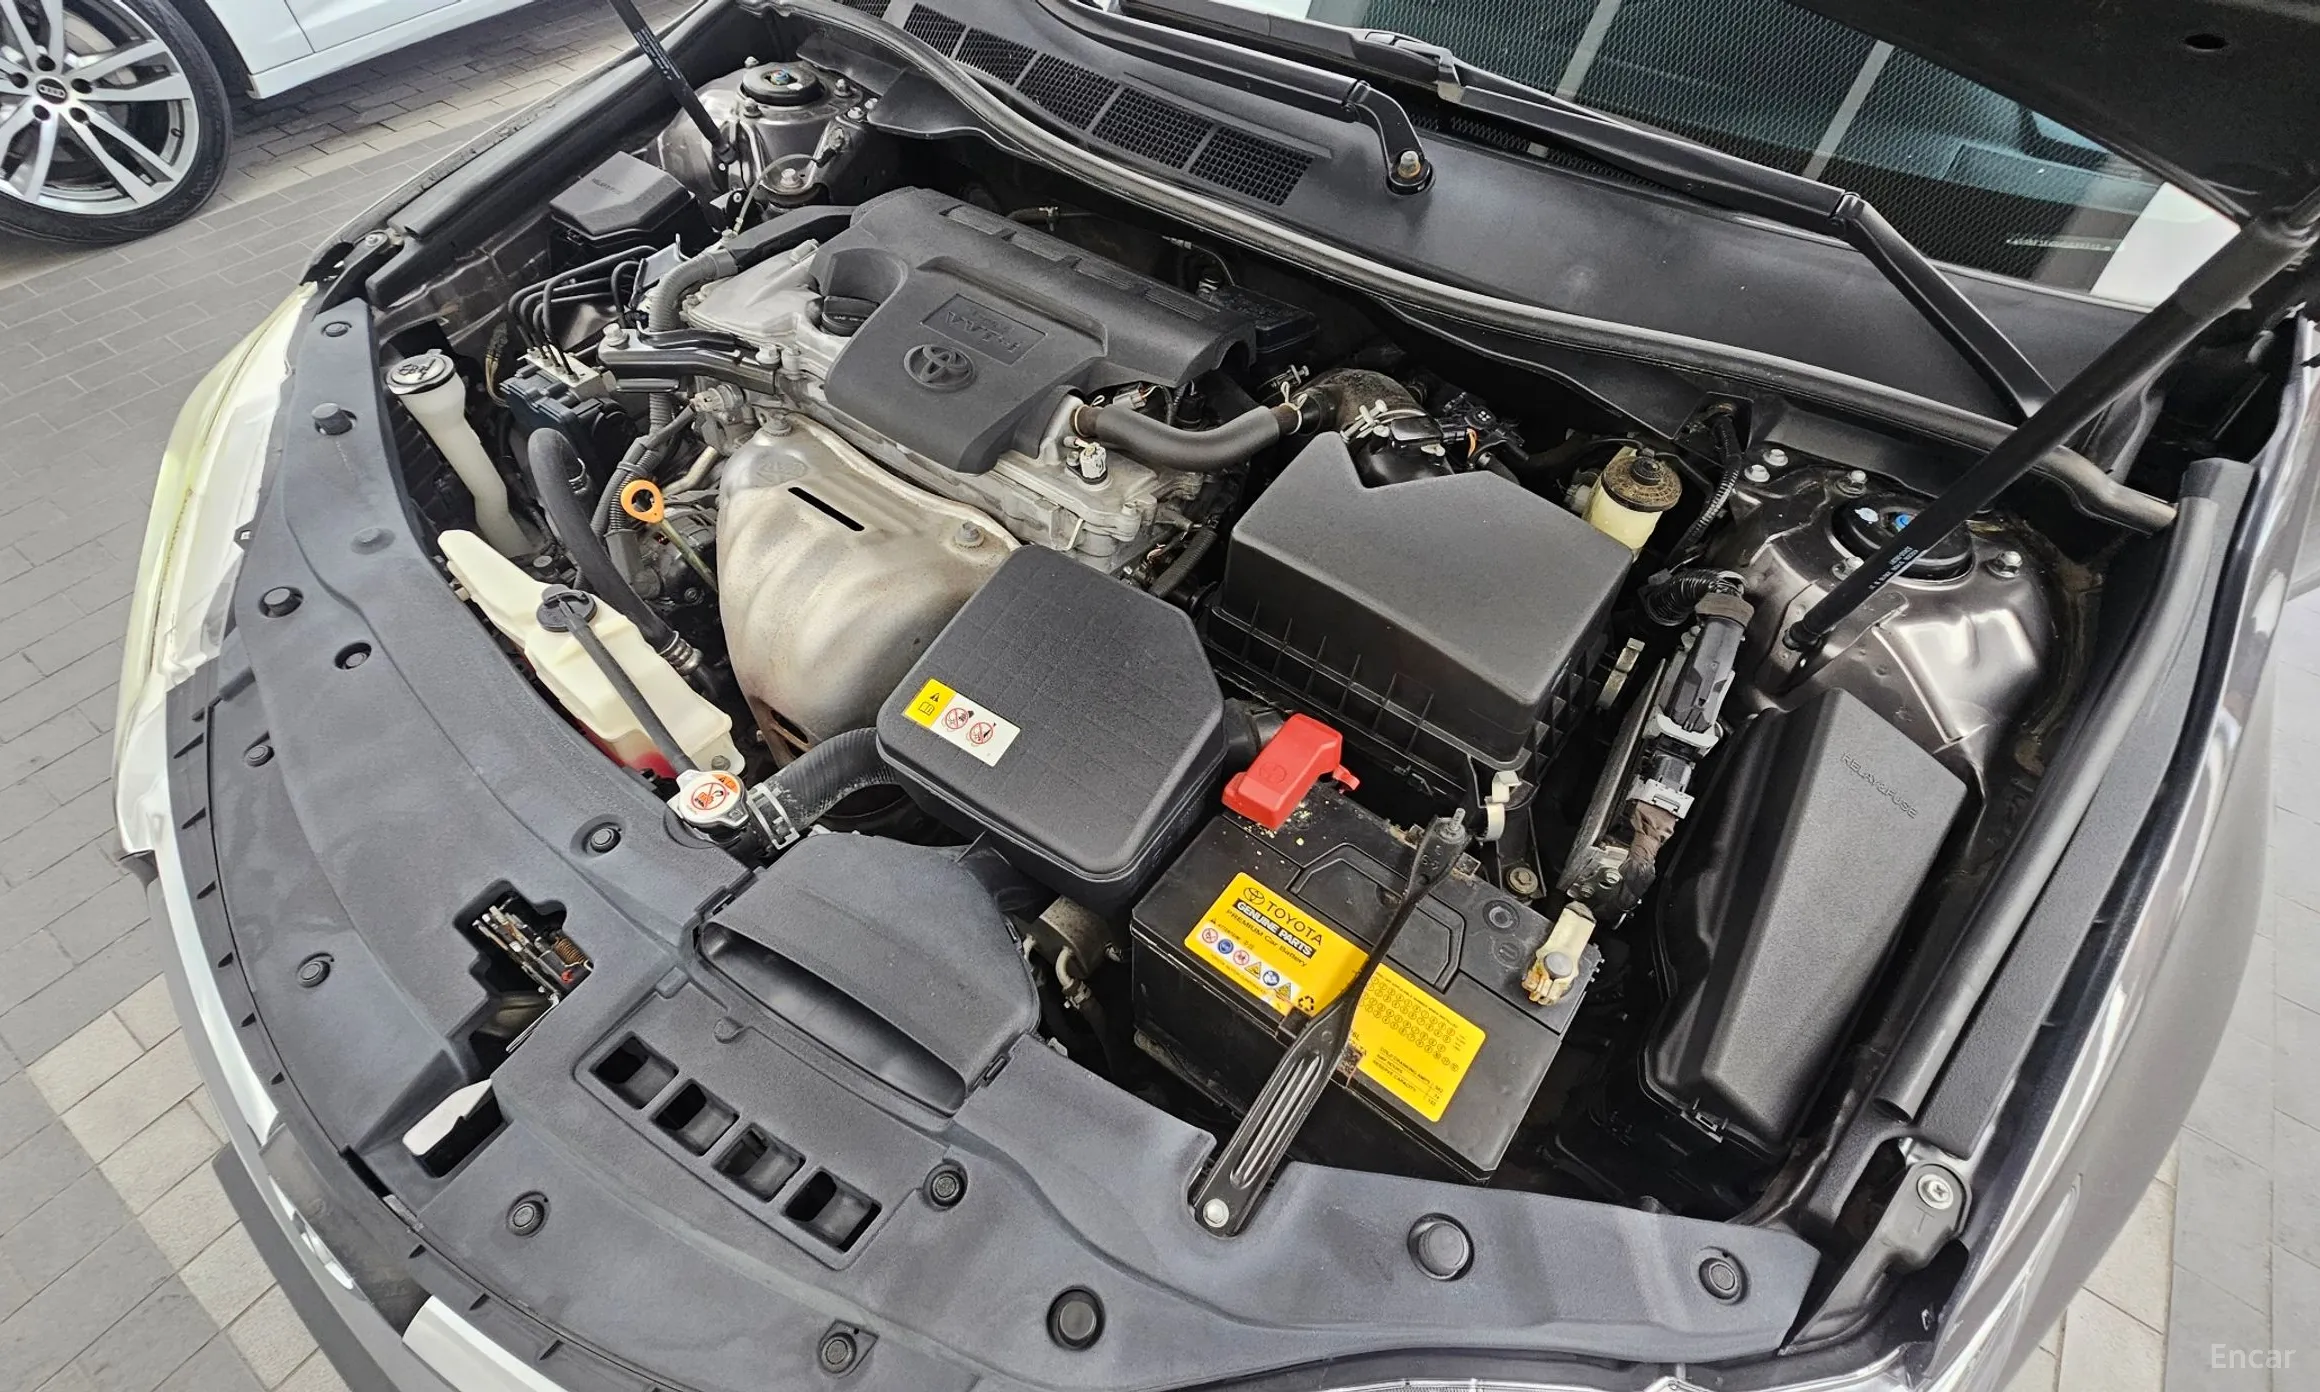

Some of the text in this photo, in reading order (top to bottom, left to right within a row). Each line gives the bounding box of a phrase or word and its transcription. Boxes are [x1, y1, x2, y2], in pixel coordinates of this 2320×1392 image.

[1226, 909, 1307, 967] PREMIUM Car Battery
[1237, 901, 1313, 957] GENUINE PARTS
[1266, 901, 1322, 946] TOYOTA
